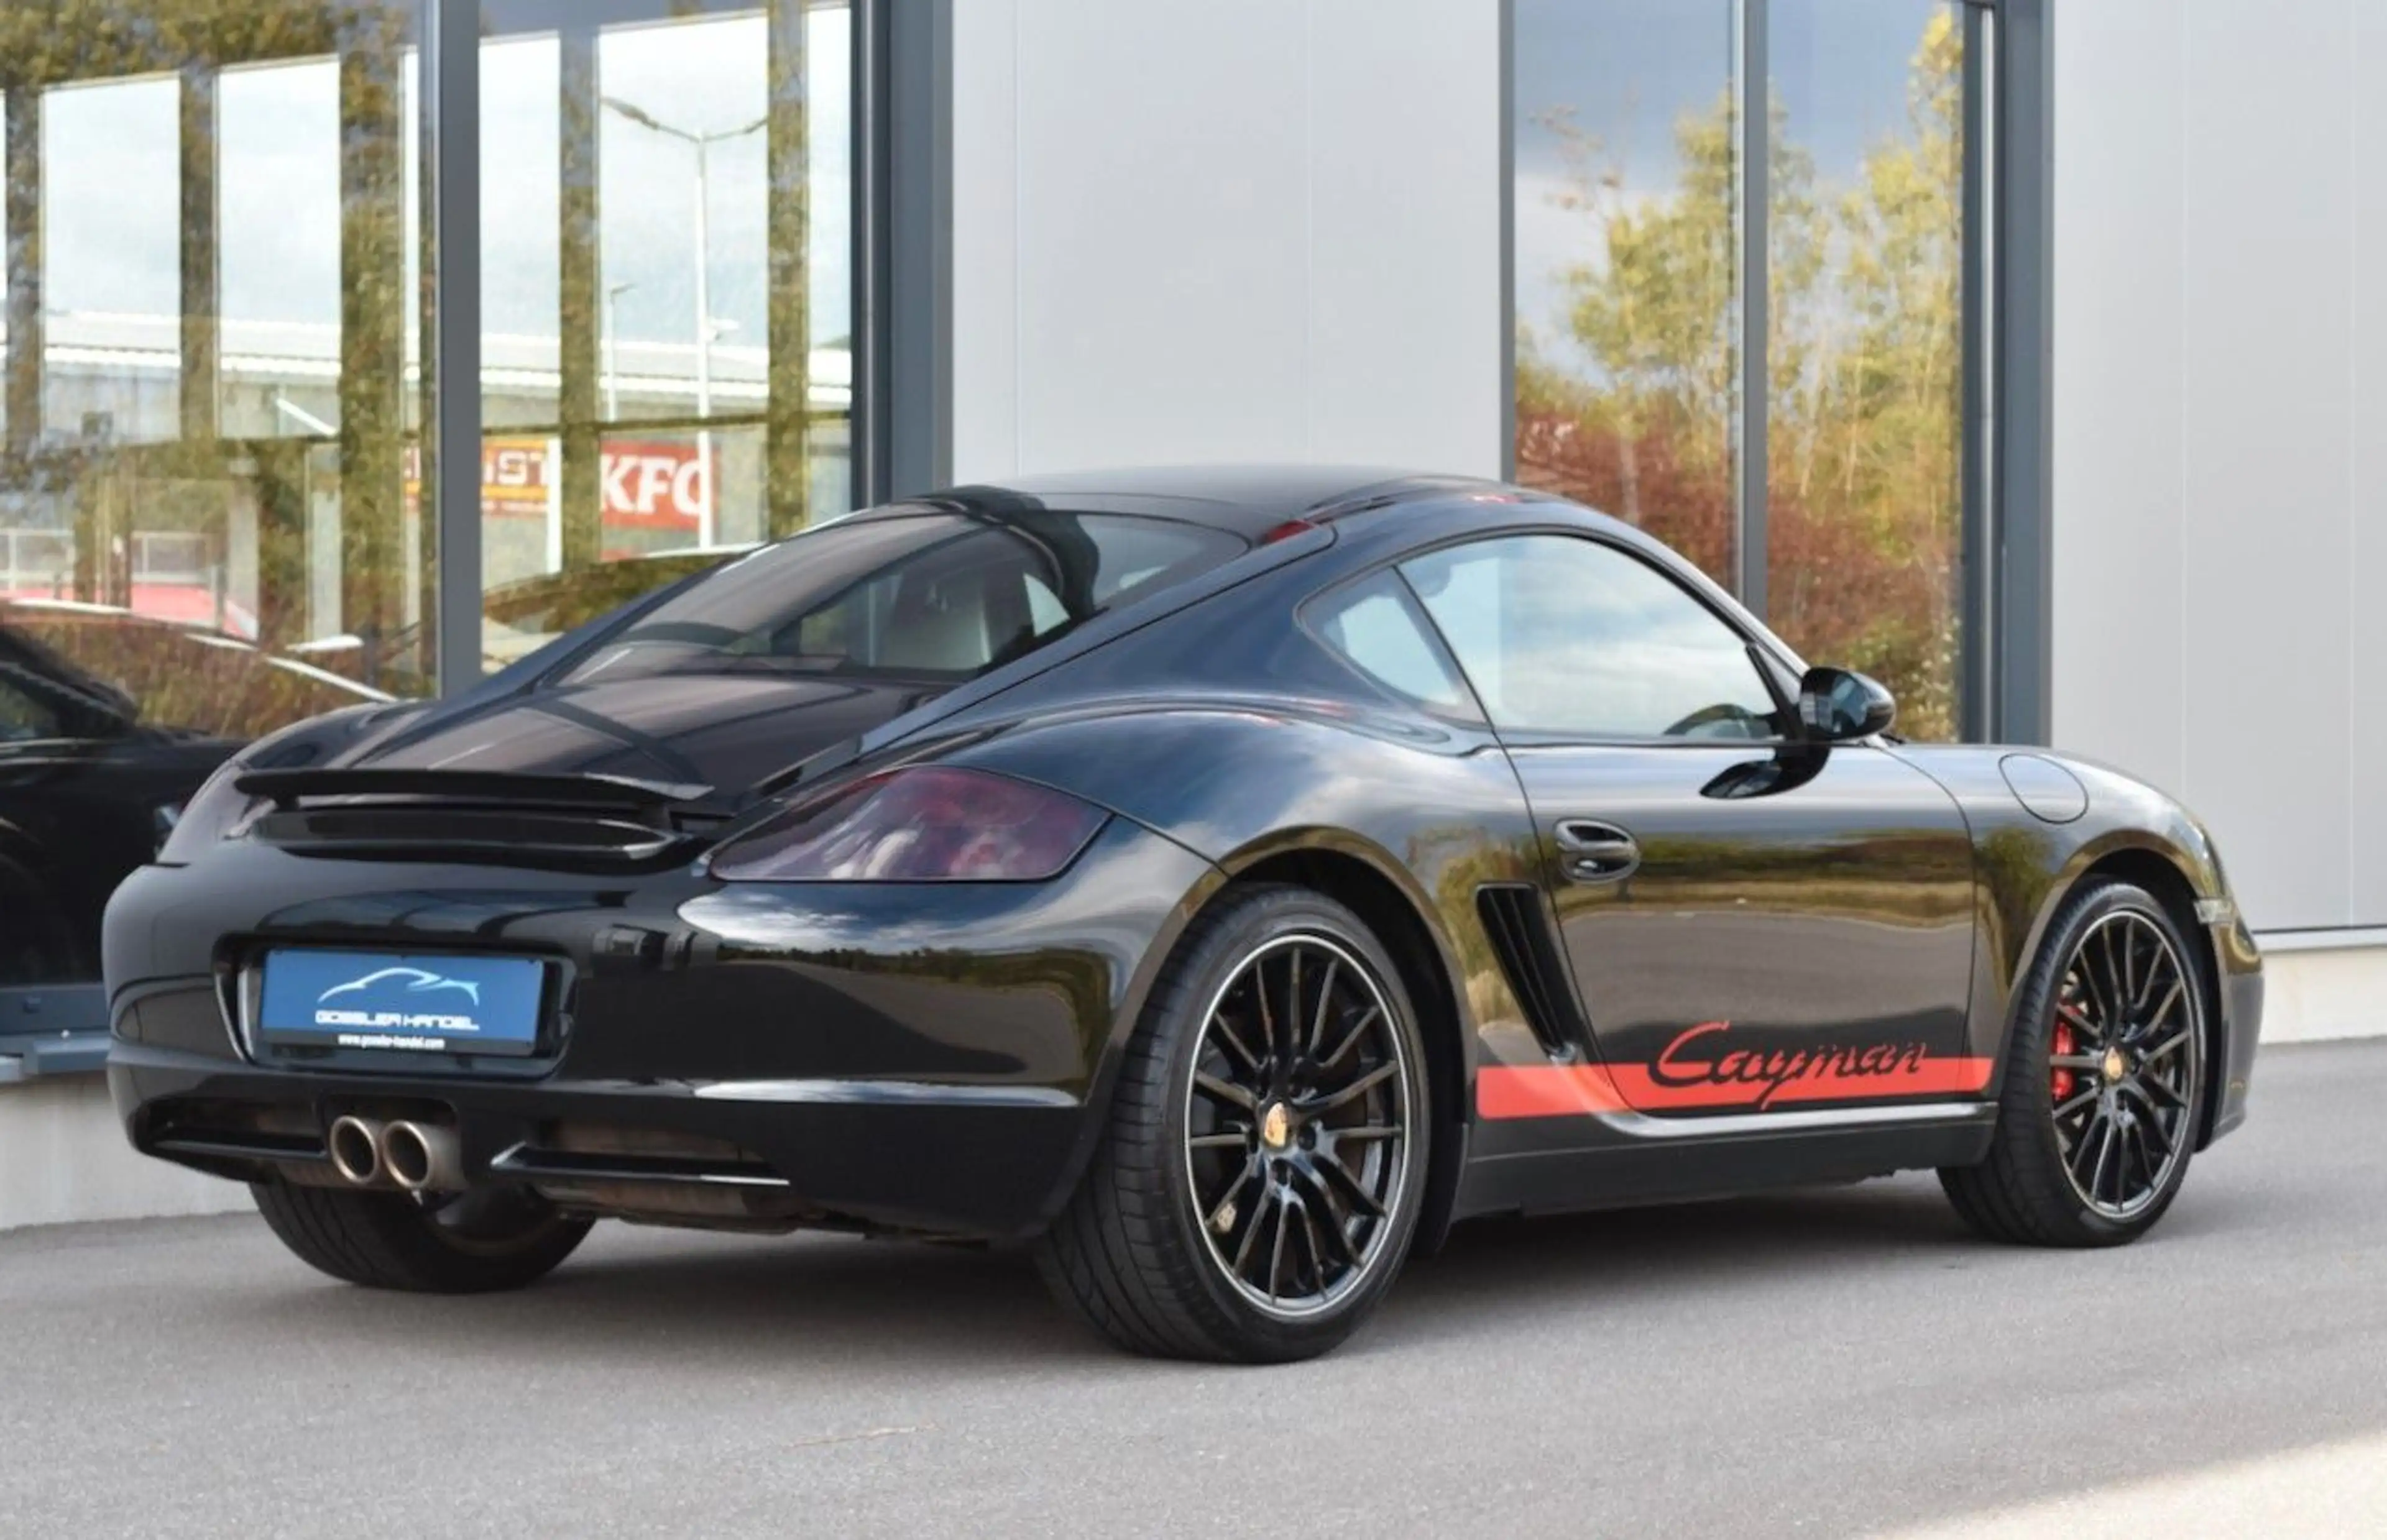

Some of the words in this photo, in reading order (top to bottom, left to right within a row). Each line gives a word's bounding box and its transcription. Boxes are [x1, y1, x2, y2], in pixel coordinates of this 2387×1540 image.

[600, 455, 710, 516] KFC
[403, 1014, 480, 1031] HANDEL
[1647, 1020, 1927, 1111] Cayman
